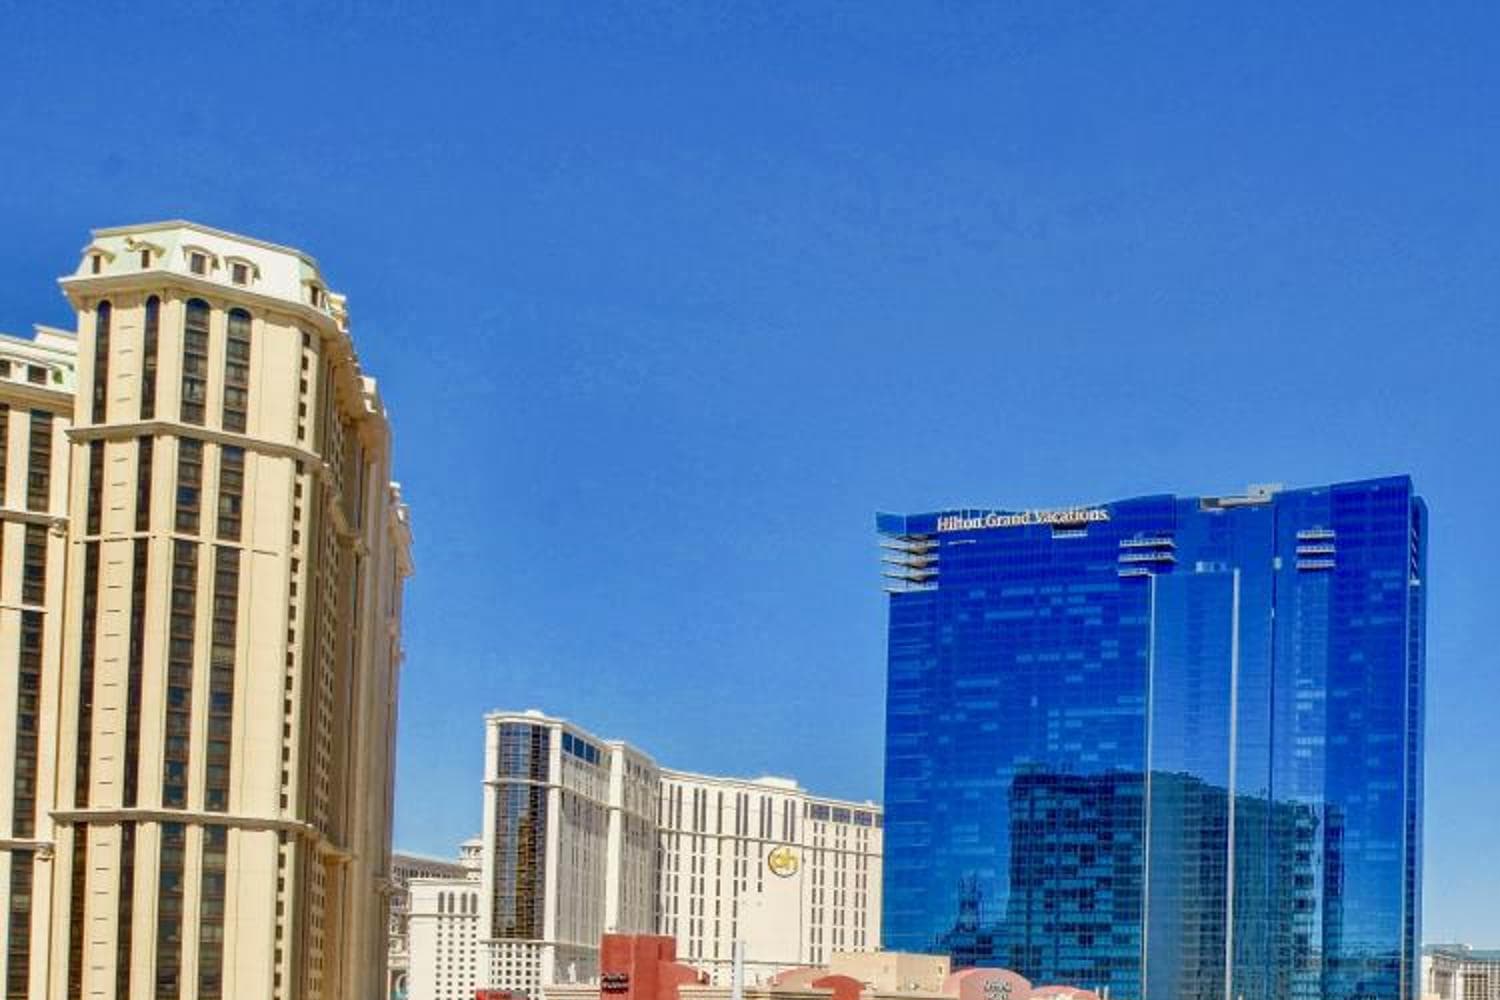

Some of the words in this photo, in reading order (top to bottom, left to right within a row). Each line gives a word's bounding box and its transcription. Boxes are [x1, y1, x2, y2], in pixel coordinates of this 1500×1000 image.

[937, 514, 983, 532] Hilton
[985, 511, 1030, 528] Grand
[1033, 508, 1110, 525] Vacations
